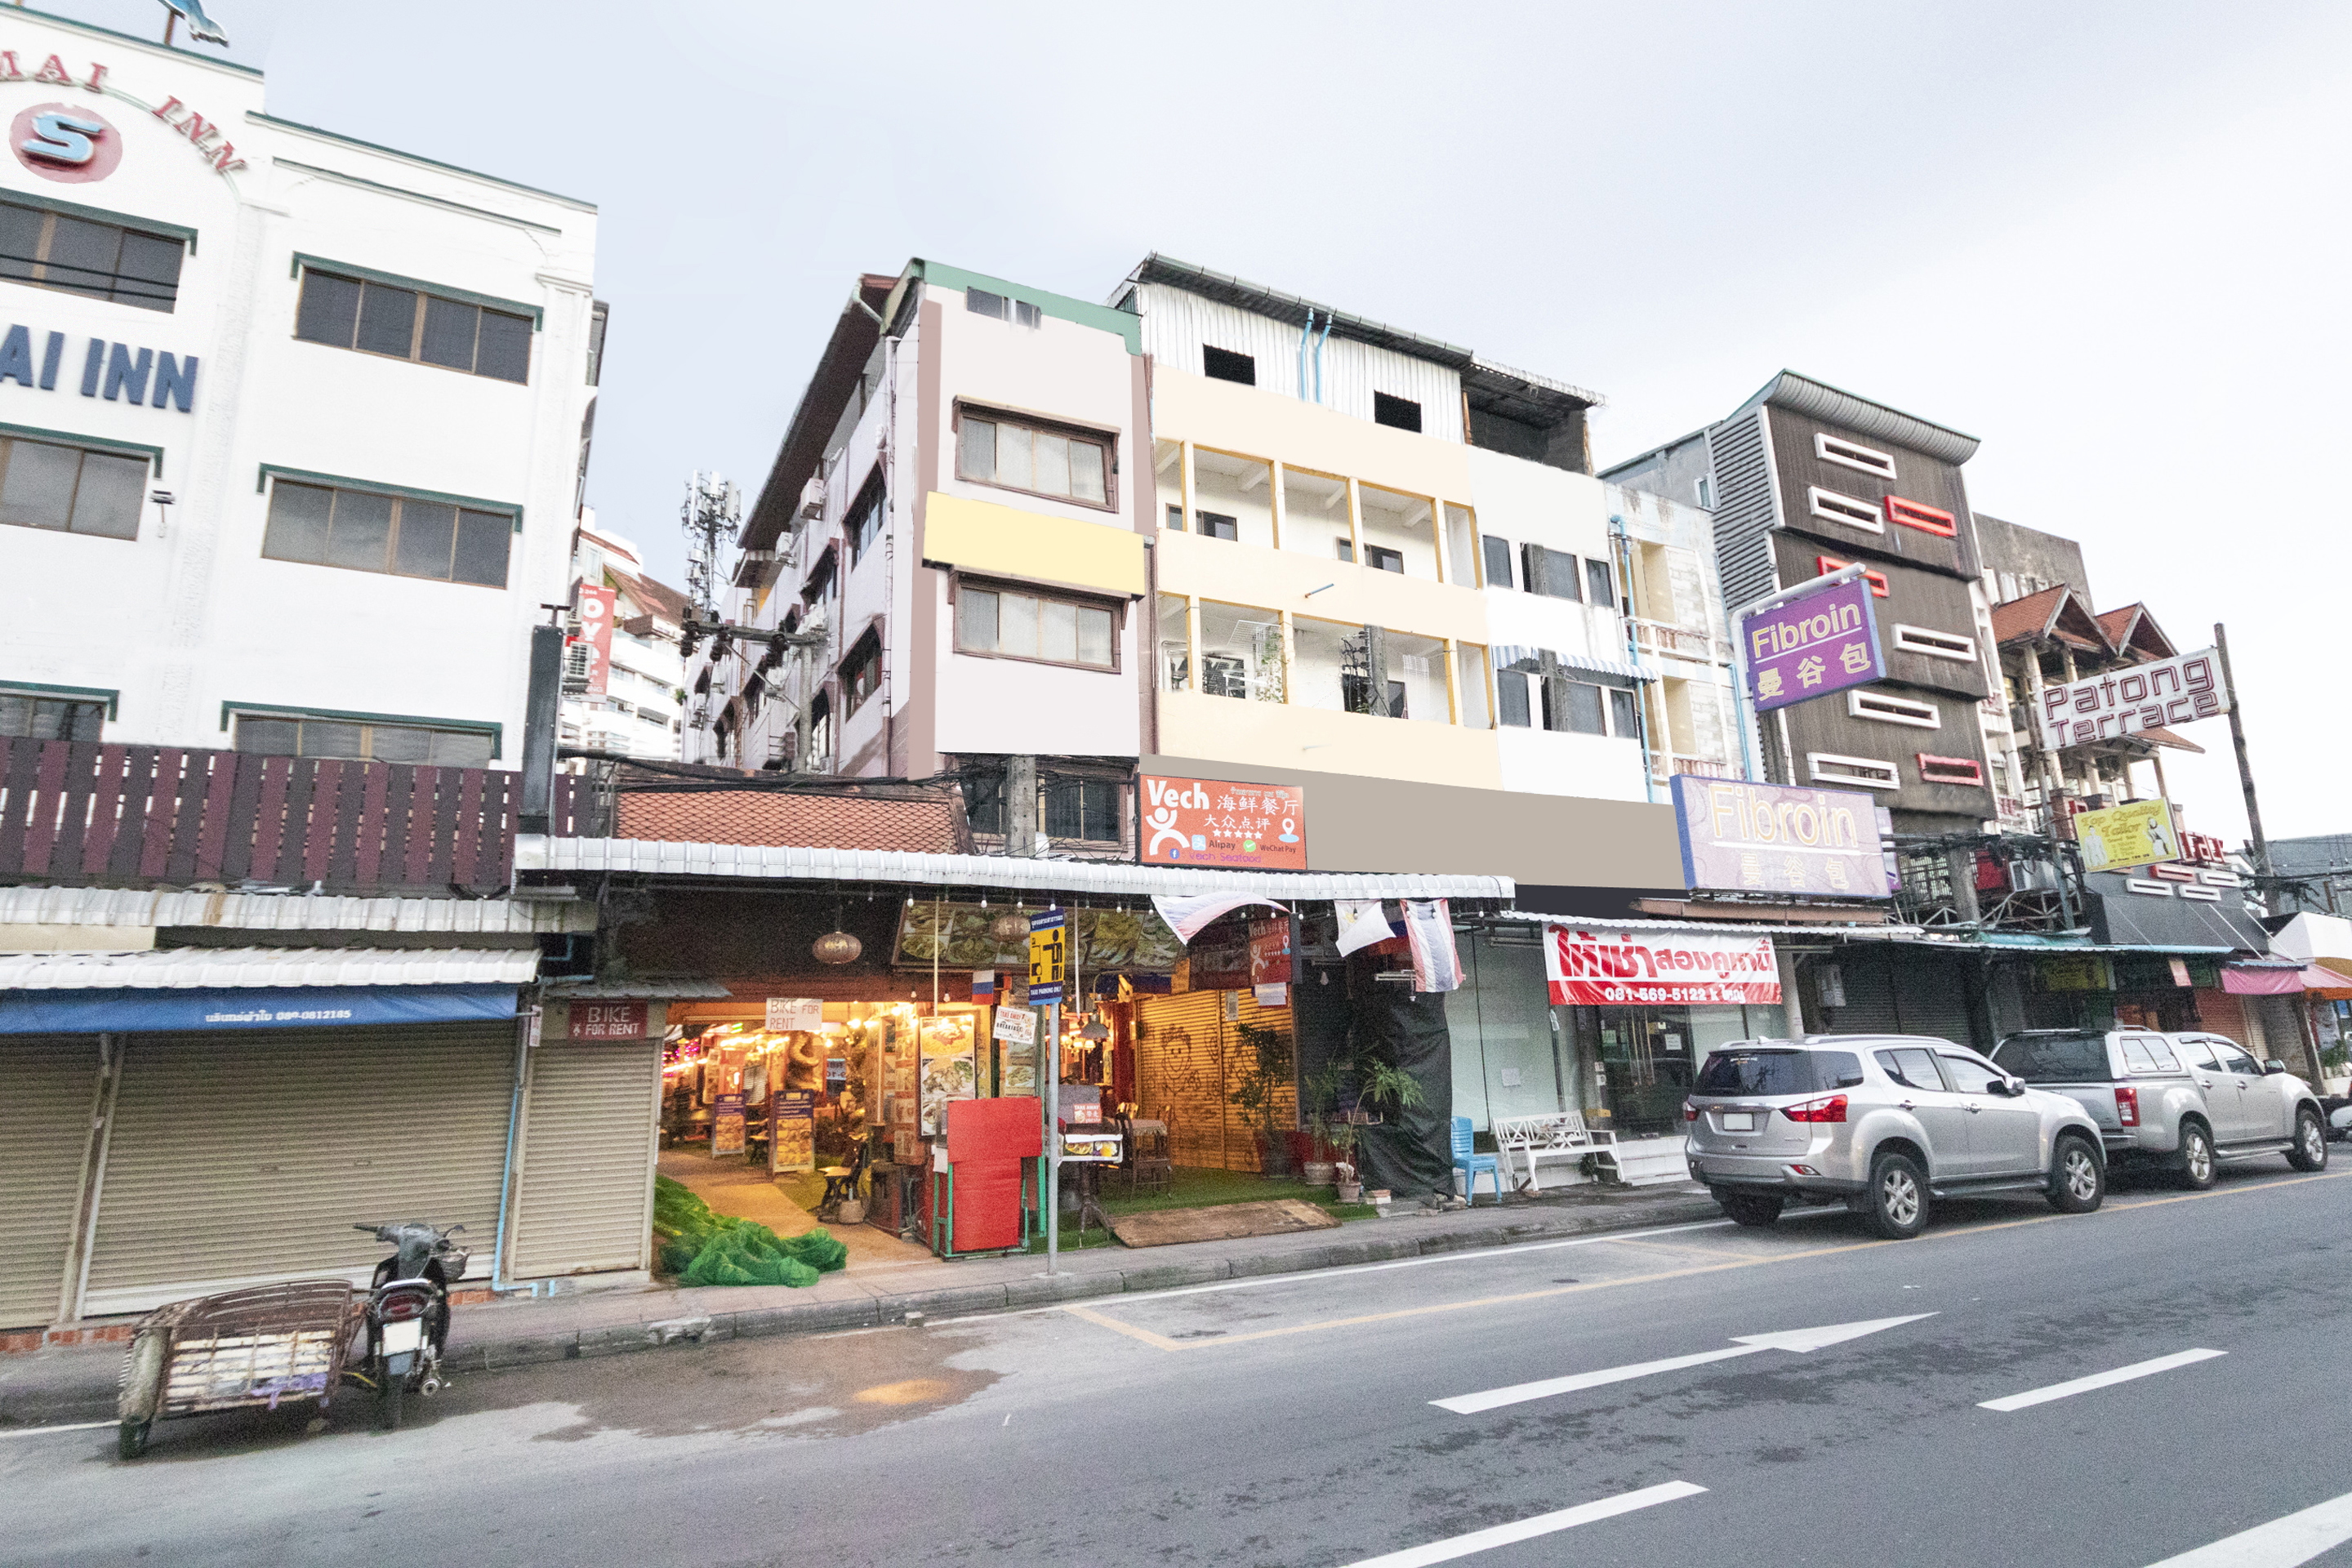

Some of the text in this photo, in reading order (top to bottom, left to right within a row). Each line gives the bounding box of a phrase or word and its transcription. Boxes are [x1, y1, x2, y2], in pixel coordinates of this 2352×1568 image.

[22, 111, 102, 169] S
[153, 95, 247, 173] INN
[81, 337, 198, 413] INN
[1752, 604, 1861, 658] Fibroin
[1757, 642, 1871, 702] 曼谷包
[2043, 657, 2215, 720] Patong
[2050, 691, 2220, 746] Terrace
[1147, 779, 1209, 809] Vech
[1217, 795, 1298, 816] 海鲜餐厅
[1204, 813, 1271, 831] 大众点评
[1708, 783, 1858, 848] Fibroin
[2081, 805, 2161, 826] Top Quality
[2101, 822, 2140, 837] Tailor
[1209, 840, 1236, 850] Alipay
[1260, 844, 1284, 853] WeChat
[1189, 852, 1261, 863] Vech Seafood
[1740, 853, 1849, 889] 曼谷包
[1249, 921, 1266, 937] Vech
[1039, 987, 1054, 995] PARKING
[1605, 987, 1707, 1001] 081-569-5122
[588, 1006, 630, 1022] BIKE
[770, 1000, 819, 1014] BIKE FOR
[586, 1022, 639, 1036] FOR RENT
[770, 1018, 795, 1029] RENT
